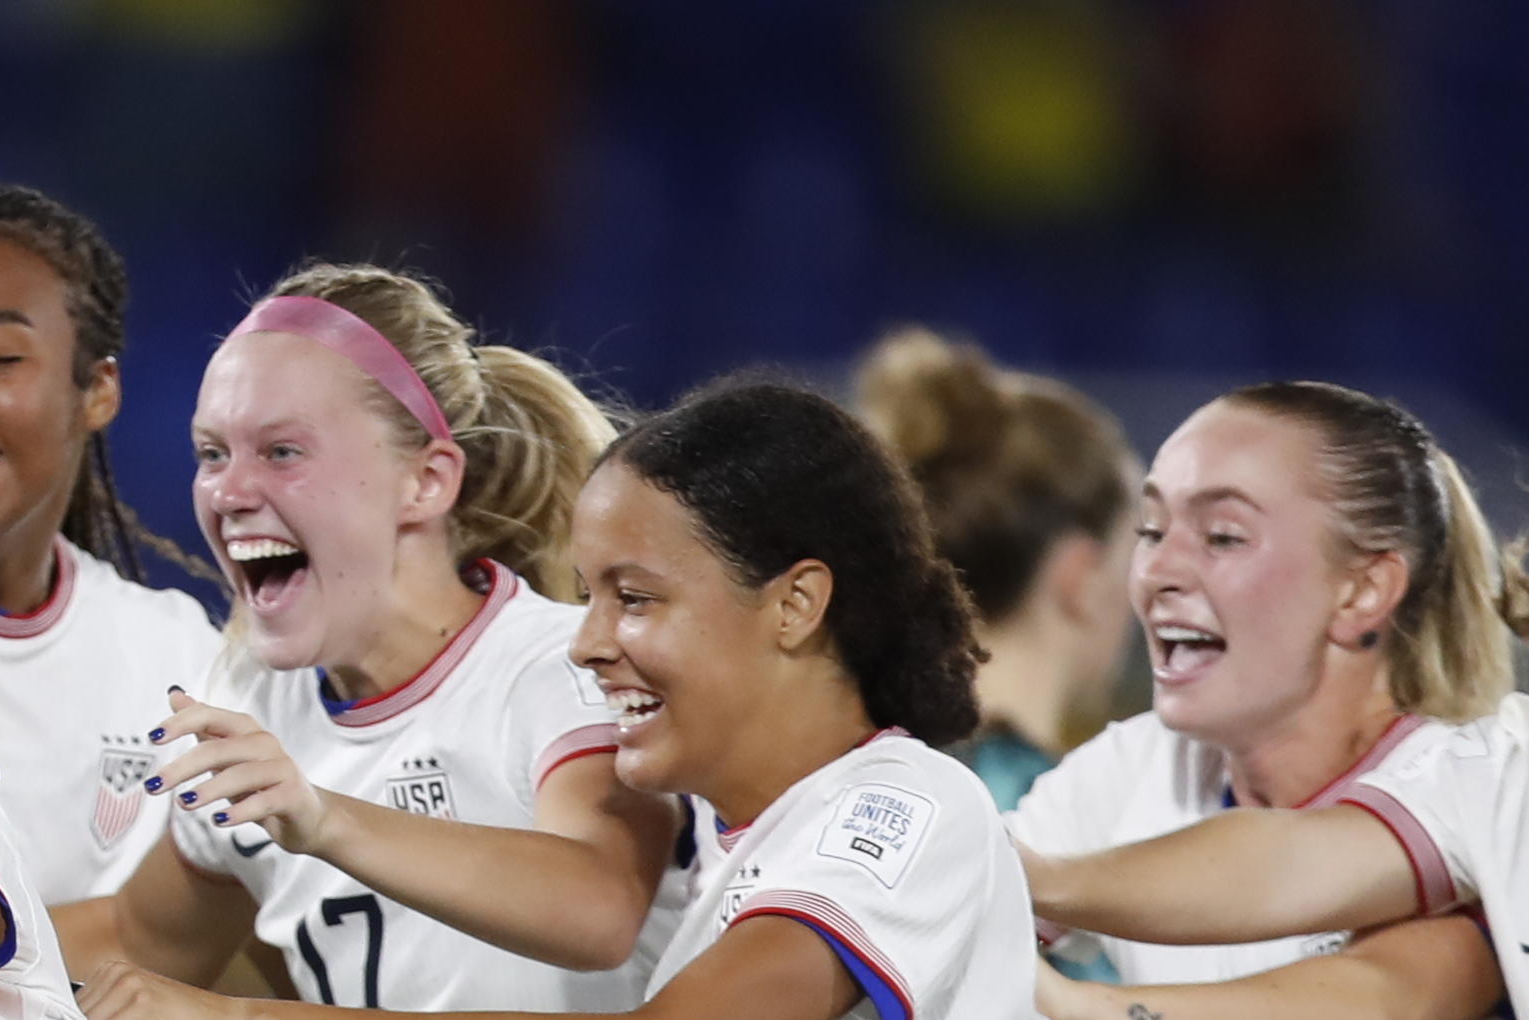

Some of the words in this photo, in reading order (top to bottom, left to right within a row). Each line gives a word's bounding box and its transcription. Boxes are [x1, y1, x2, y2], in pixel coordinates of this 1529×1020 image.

[392, 781, 445, 815] USA
[858, 792, 913, 819] FOOTBALL
[841, 818, 864, 832] the
[865, 822, 907, 853] World
[851, 802, 911, 835] UNITES
[297, 893, 383, 1008] 17
